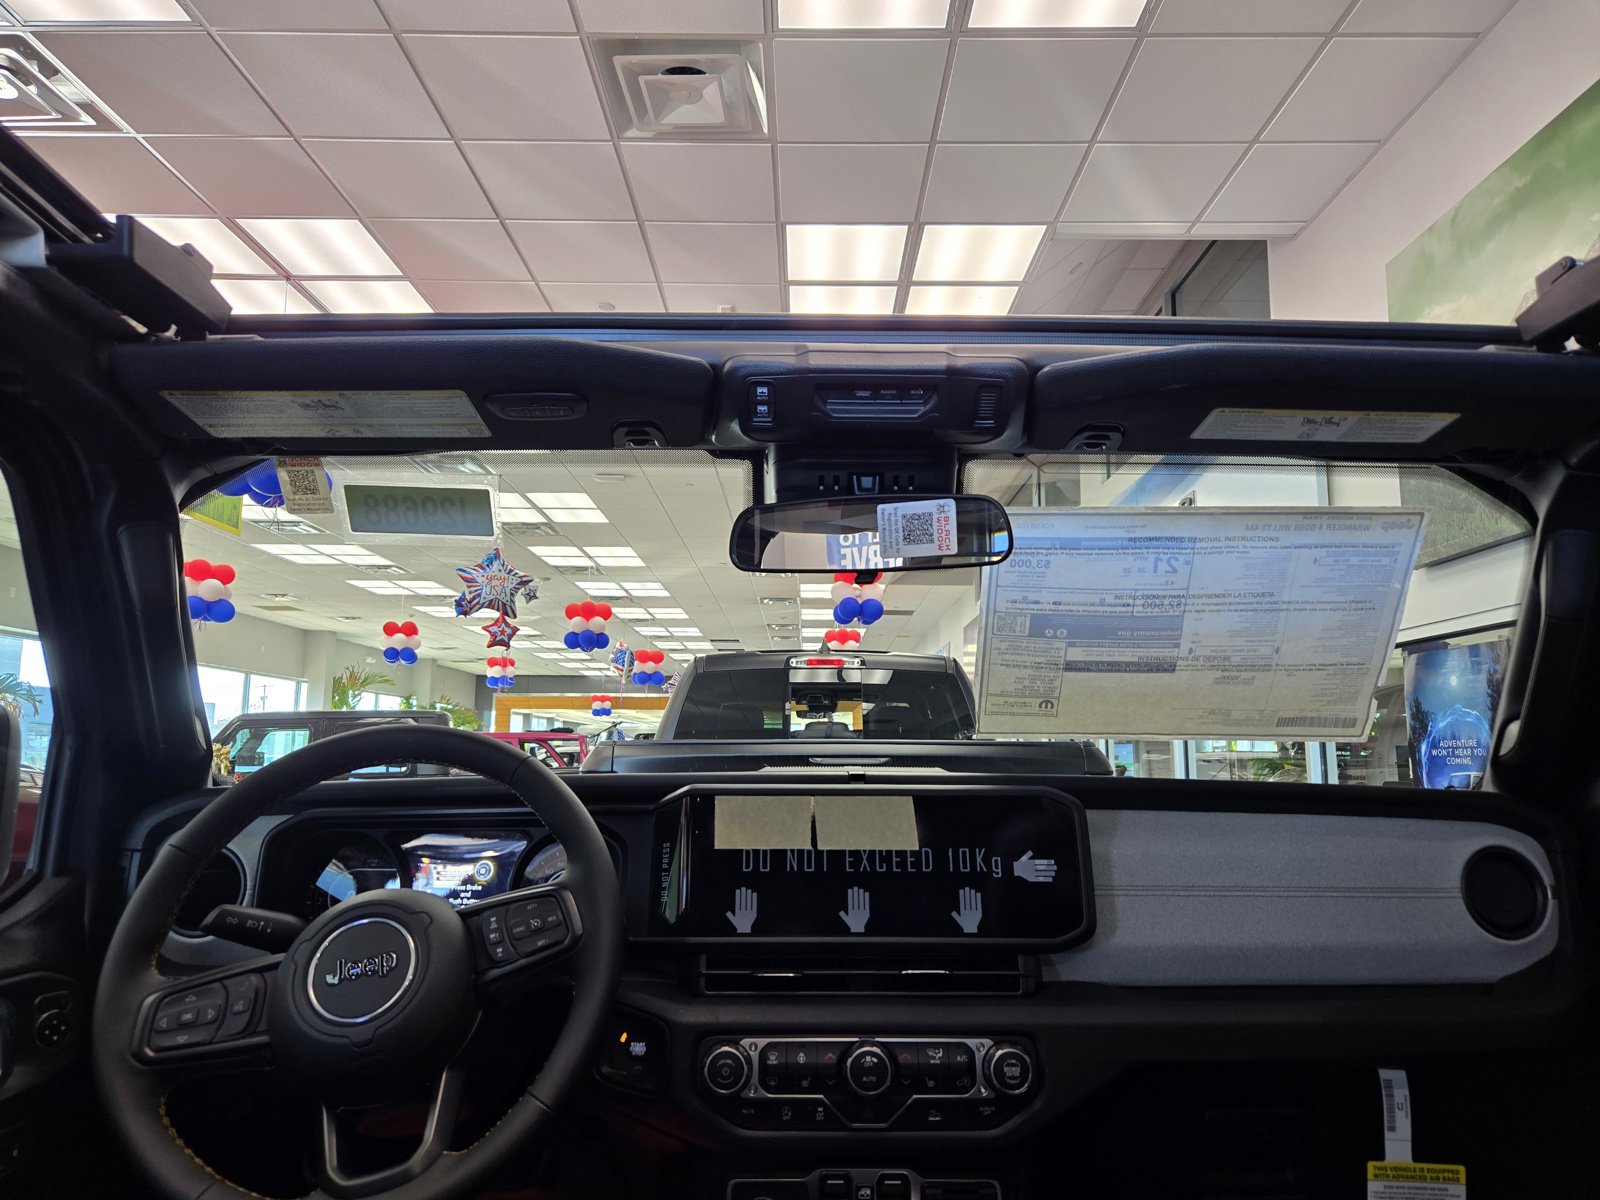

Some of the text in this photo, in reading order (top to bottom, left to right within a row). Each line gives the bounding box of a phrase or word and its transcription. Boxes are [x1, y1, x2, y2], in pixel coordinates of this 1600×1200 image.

[936, 516, 944, 552] WIDOW
[1127, 535, 1281, 544] RECOMMENDED REMOVAL INSTRUCTIONS
[486, 573, 509, 585] yay!
[485, 584, 507, 597] USA
[1188, 592, 1231, 600] DESPRENDER
[1439, 739, 1477, 747] ADVENTURE
[1431, 748, 1487, 756] WON'T HEAR YOU
[1446, 757, 1473, 765] COMING.
[742, 848, 1002, 878] DO NOT EXCEED 10Kg
[661, 842, 670, 902] DO NOT PRESS
[325, 950, 398, 986] Jeep
[1426, 1167, 1461, 1175] EQUIPPED
[1441, 1175, 1460, 1183] BAGS
